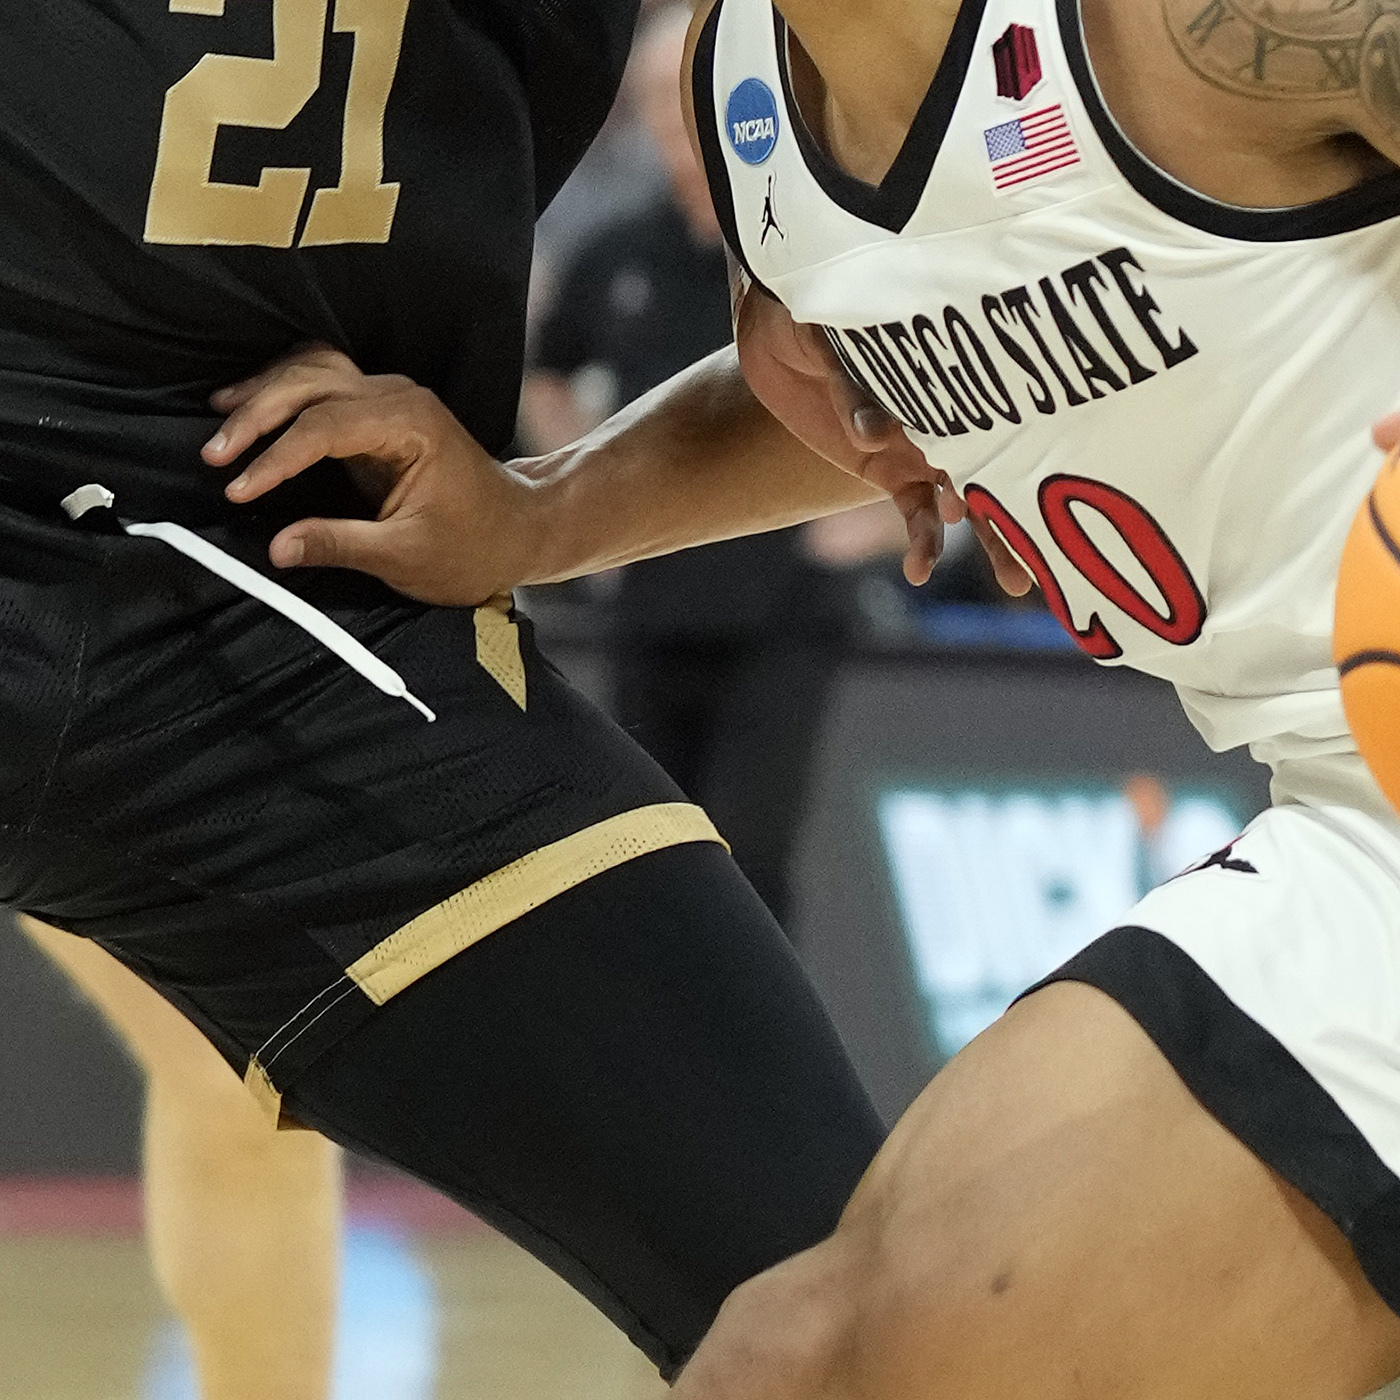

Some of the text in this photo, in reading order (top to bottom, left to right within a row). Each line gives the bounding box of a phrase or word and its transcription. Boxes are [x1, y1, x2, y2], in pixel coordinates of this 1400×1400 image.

[733, 116, 776, 145] NCAA
[843, 305, 1022, 438] DIEGO
[981, 246, 1200, 415] STATE
